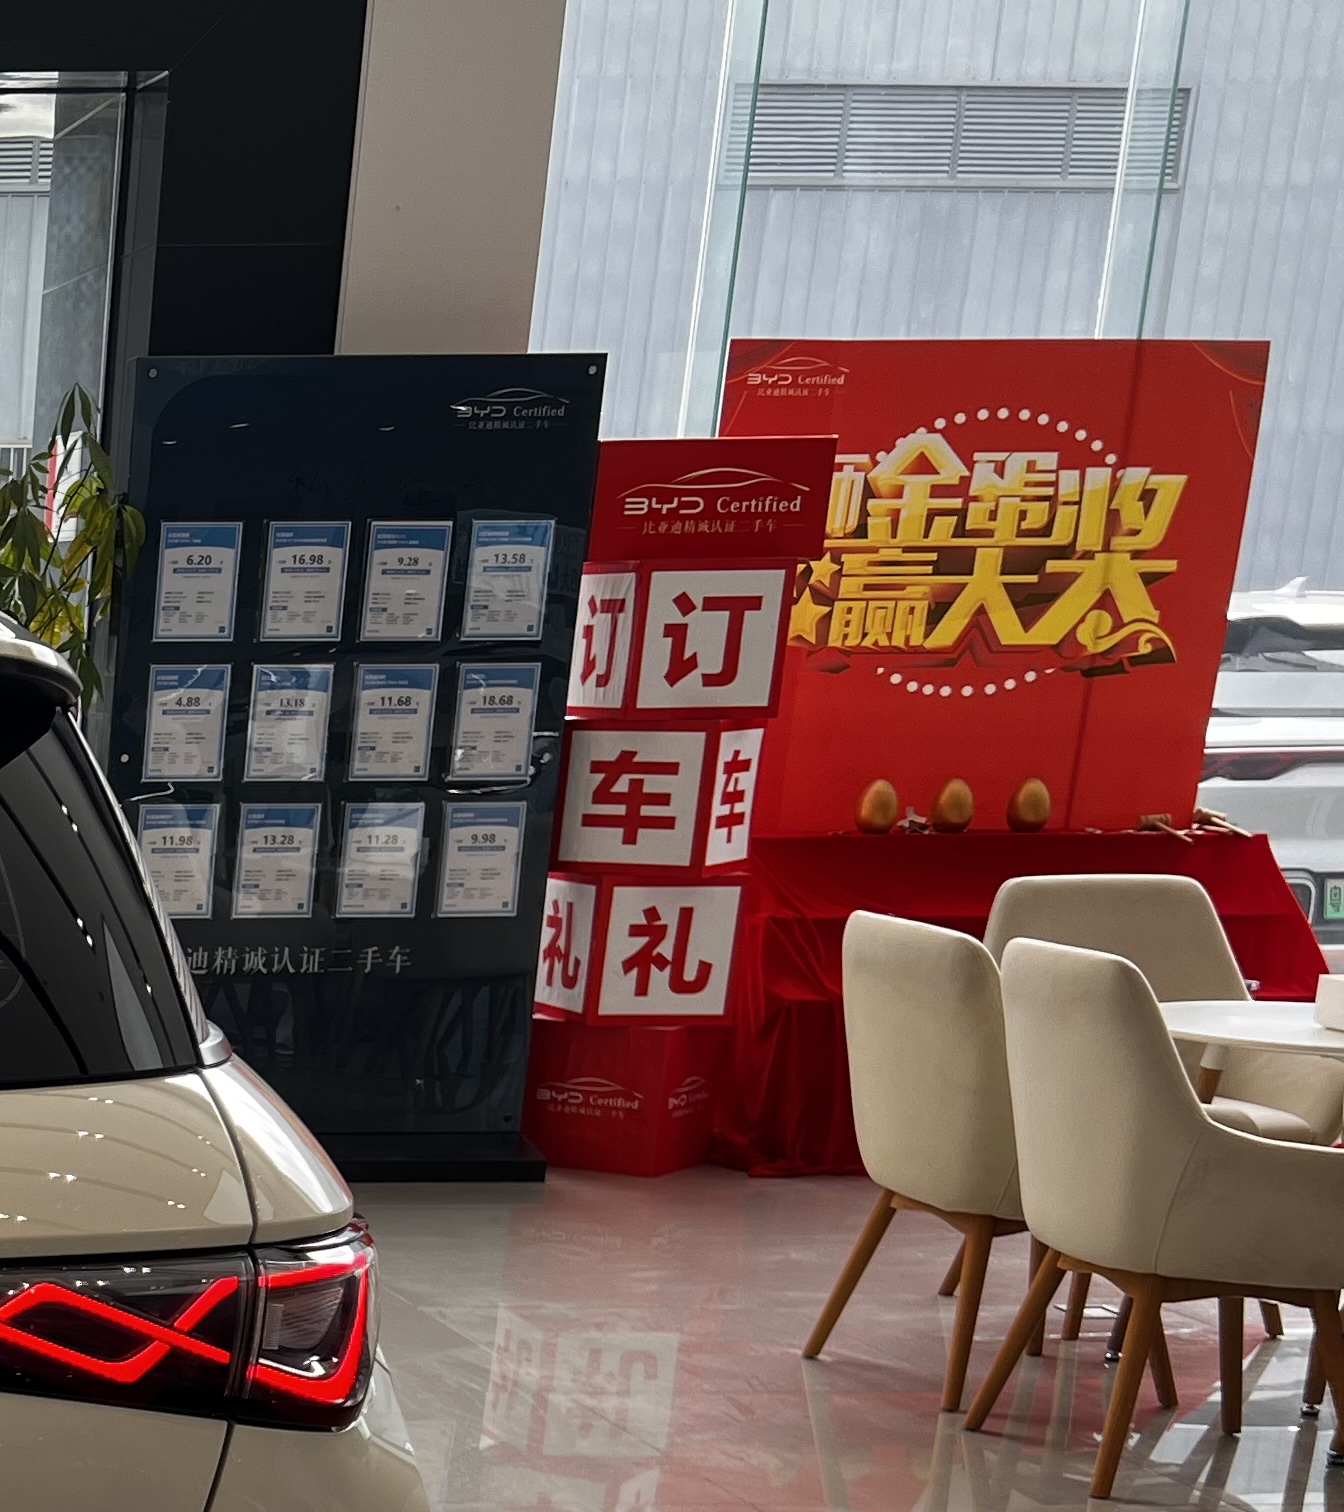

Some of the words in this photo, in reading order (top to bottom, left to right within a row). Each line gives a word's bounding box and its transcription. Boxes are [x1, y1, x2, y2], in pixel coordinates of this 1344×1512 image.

[798, 373, 845, 385] Certified
[513, 405, 565, 417] Certified
[623, 496, 705, 515] BYD
[716, 495, 802, 514] Certified
[186, 554, 212, 567] 6.20
[291, 554, 324, 566] 16.98
[397, 556, 420, 567] 9.28
[493, 553, 526, 565] 13.58
[580, 594, 625, 688] 订
[663, 591, 764, 688] 订
[175, 696, 201, 708] 4.88
[379, 696, 412, 707] 11.68
[482, 695, 514, 706] 18.68
[580, 750, 680, 845] 车
[715, 750, 752, 844] 车
[161, 835, 194, 846] 11.98
[263, 834, 295, 846] 13.28
[470, 833, 497, 845] 9.98
[542, 899, 581, 990] 礼
[621, 905, 713, 998] 礼
[187, 945, 412, 975] 迪精诚认证二手车
